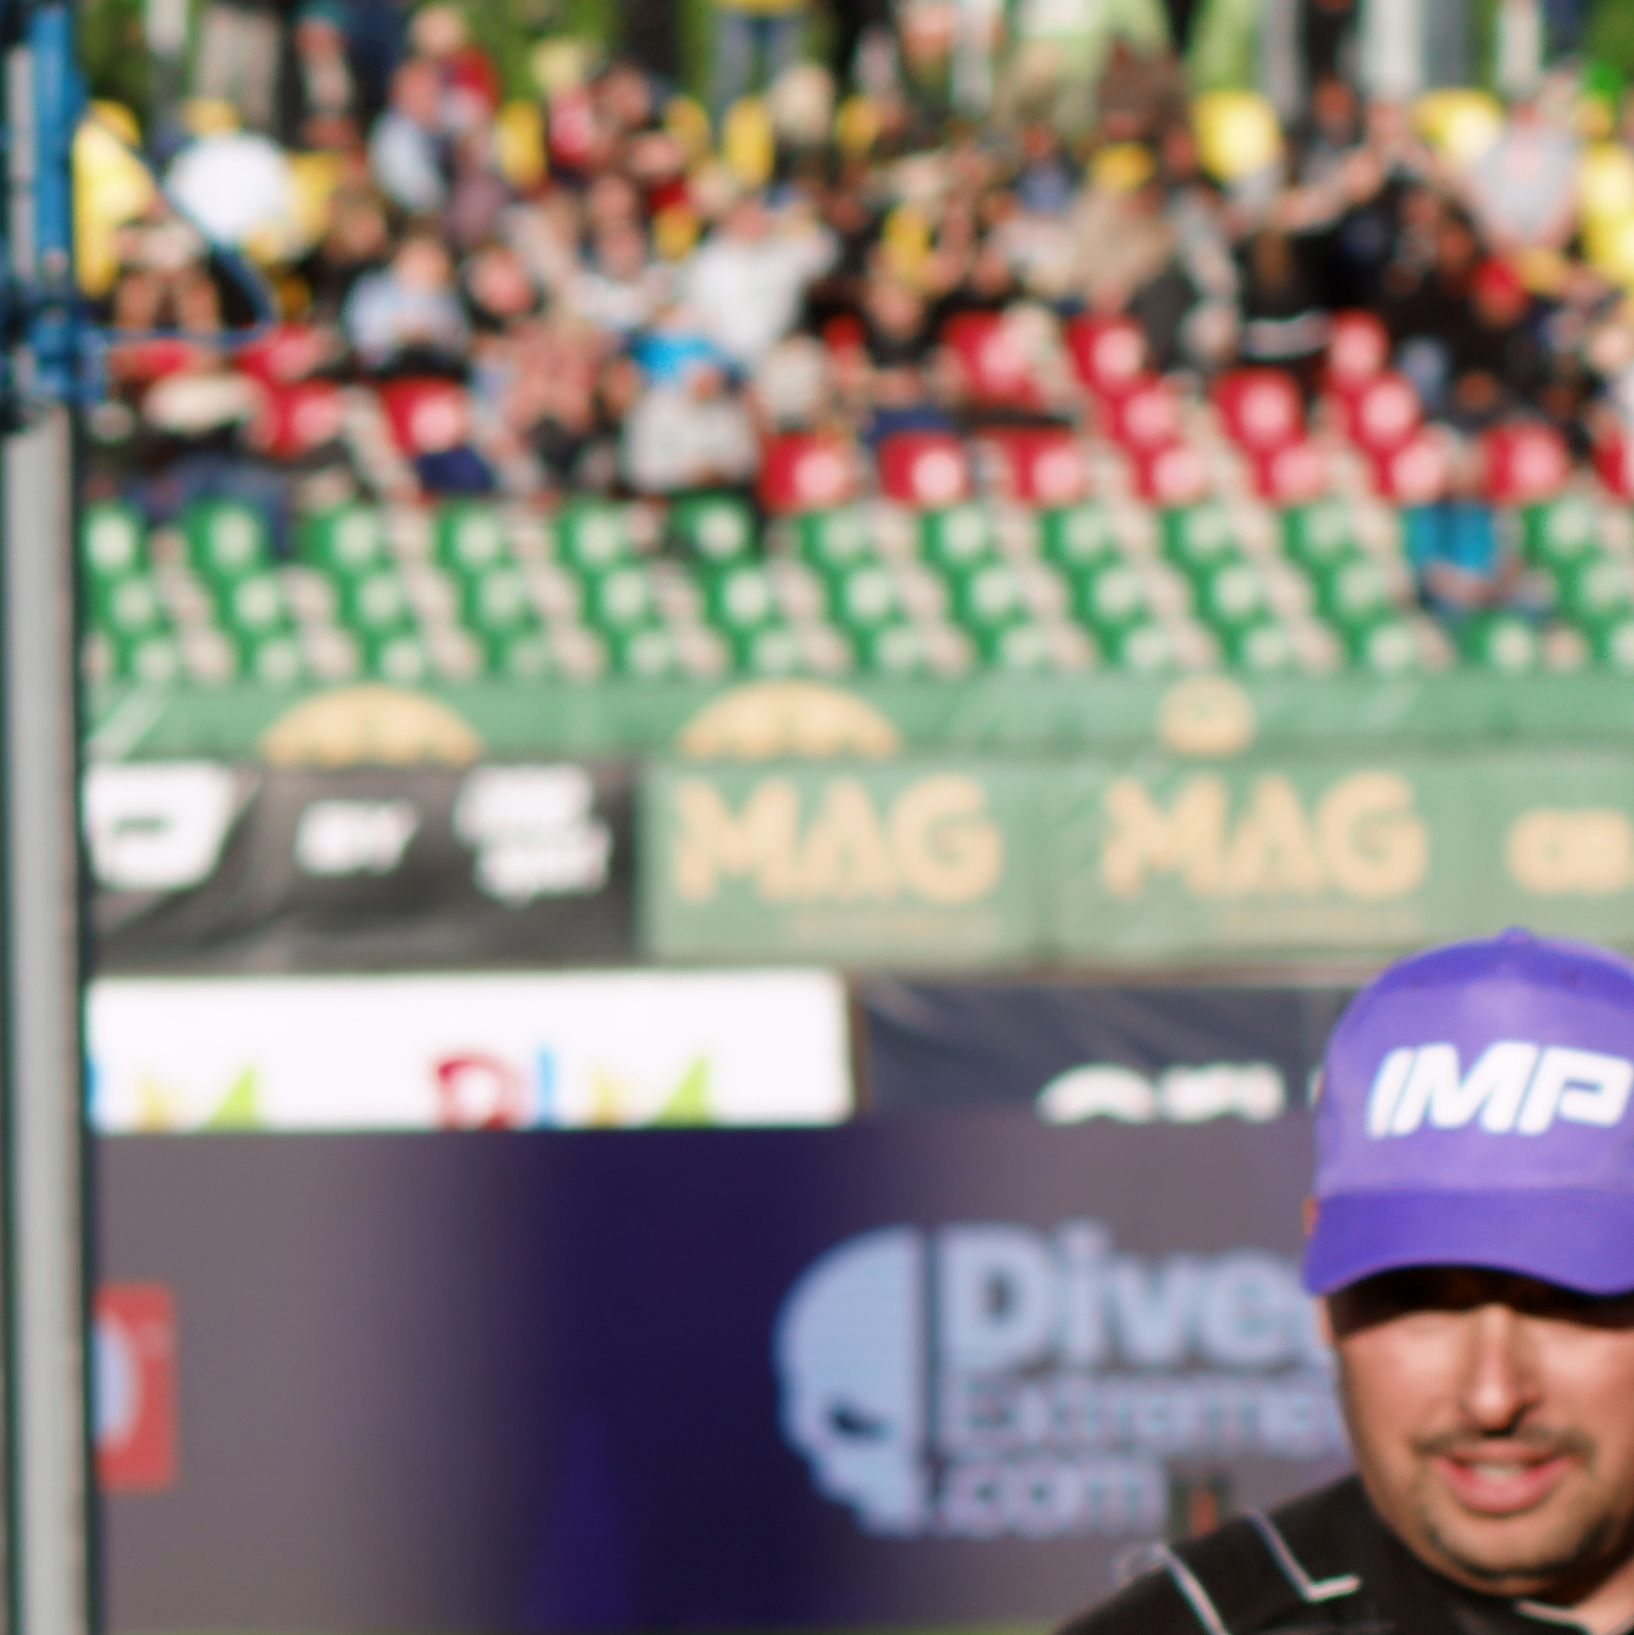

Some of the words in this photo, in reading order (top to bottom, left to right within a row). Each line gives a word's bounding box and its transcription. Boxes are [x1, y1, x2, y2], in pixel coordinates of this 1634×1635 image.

[672, 772, 1004, 903] MAG
[1102, 770, 1429, 902] MAG
[1366, 1040, 1633, 1139] IMP
